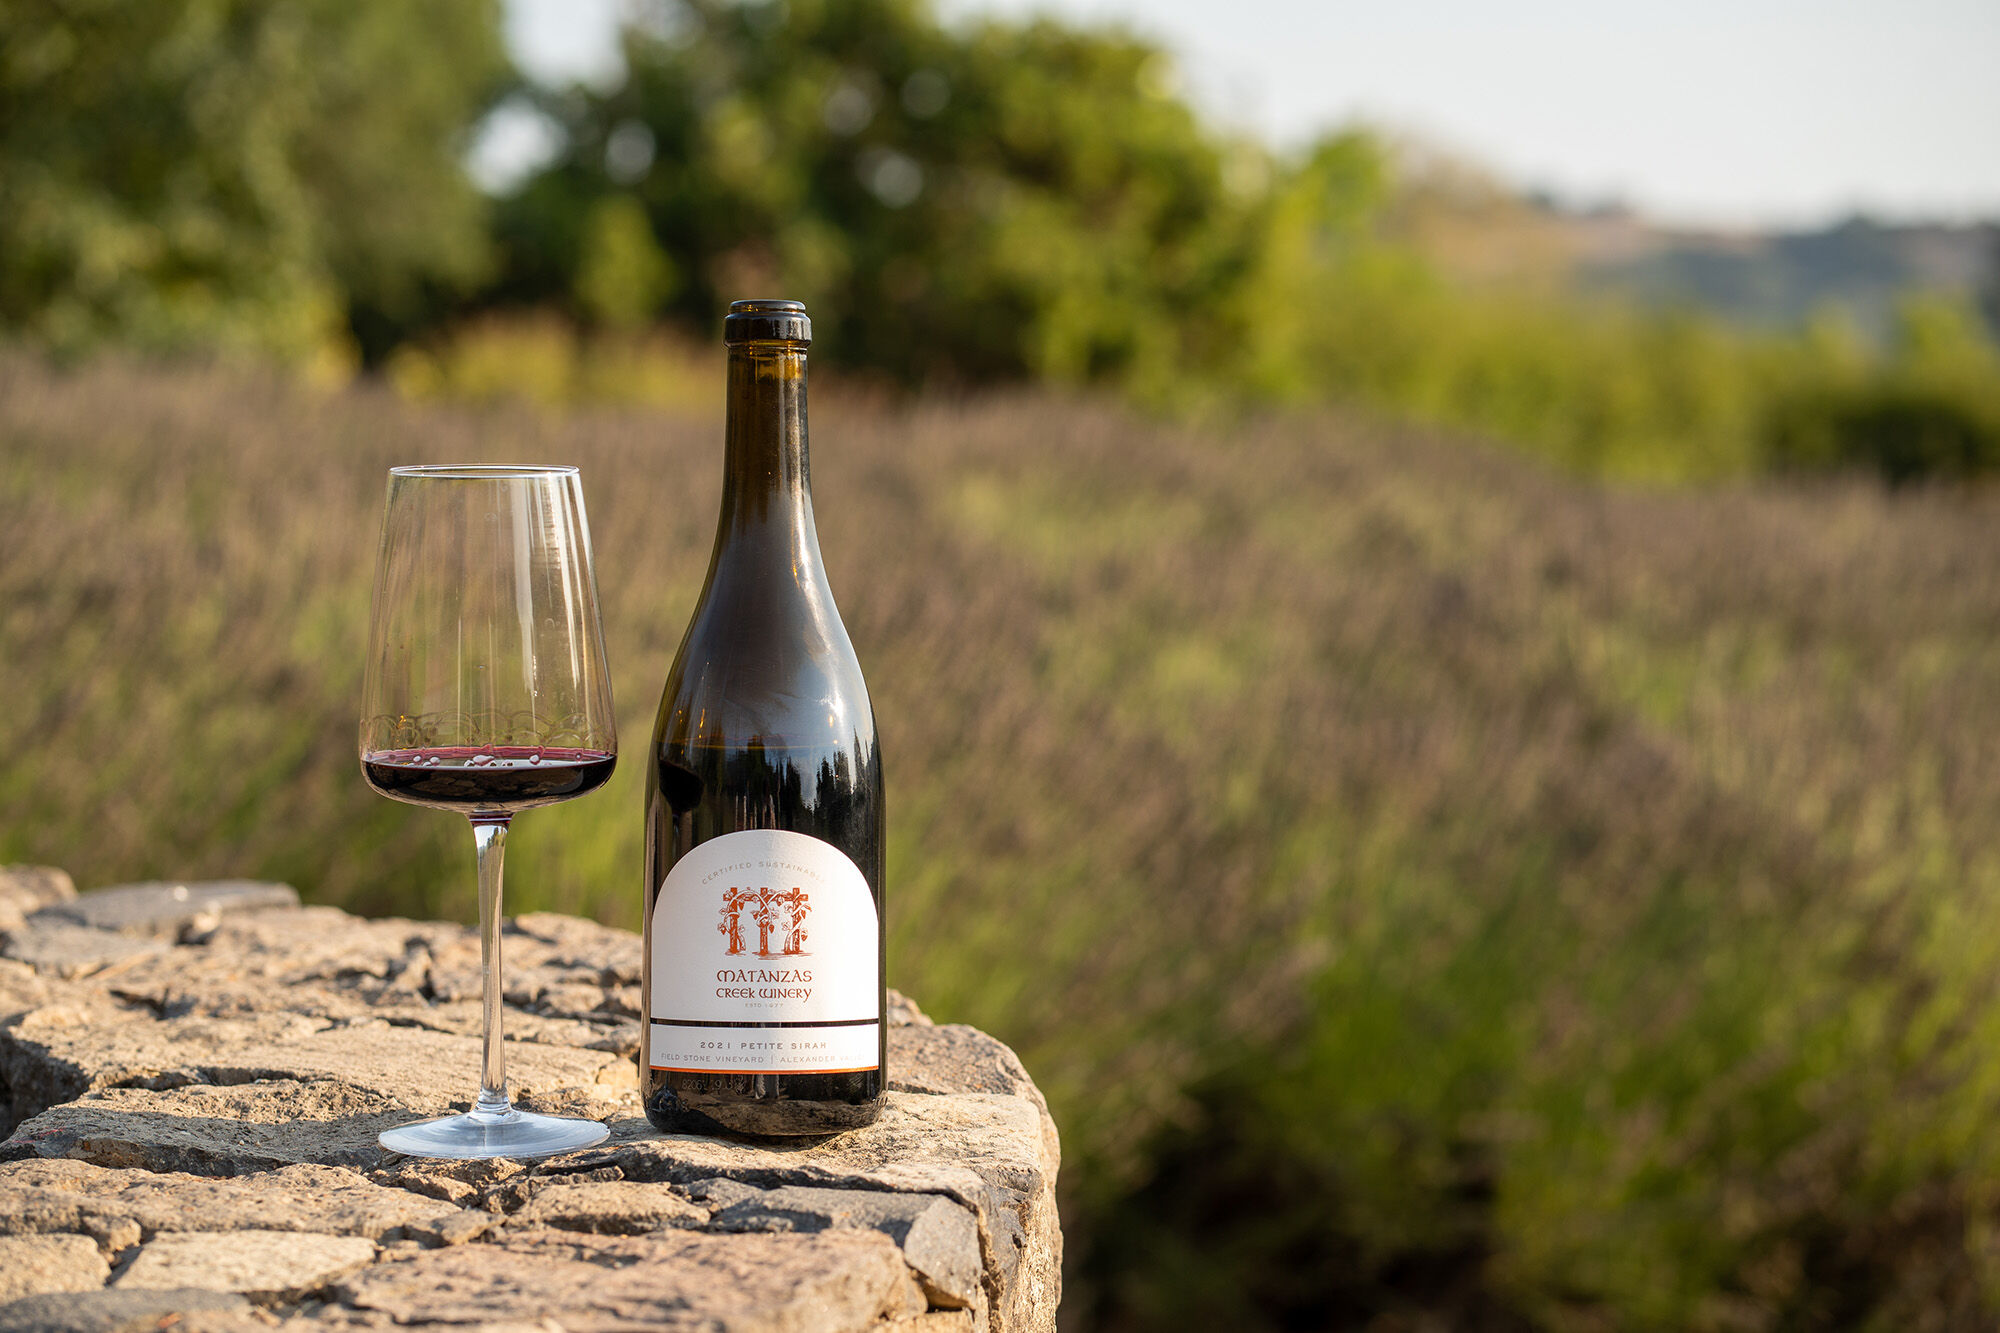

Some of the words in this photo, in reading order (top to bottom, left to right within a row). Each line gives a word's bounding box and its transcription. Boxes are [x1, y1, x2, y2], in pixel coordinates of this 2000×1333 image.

[702, 861, 752, 885] CERTIFIED
[758, 861, 825, 883] SUSTAINAB
[716, 969, 813, 983] MATANZAS
[716, 987, 755, 999] CREEK
[758, 988, 812, 1003] WINERY
[700, 1041, 731, 1049] 2021
[740, 1042, 783, 1050] PETITE
[791, 1042, 827, 1050] SIRAH
[661, 1052, 680, 1061] FIELD
[683, 1054, 711, 1062] STONE
[715, 1055, 764, 1063] VINEYARD
[779, 1055, 835, 1063] ALEXANDER
